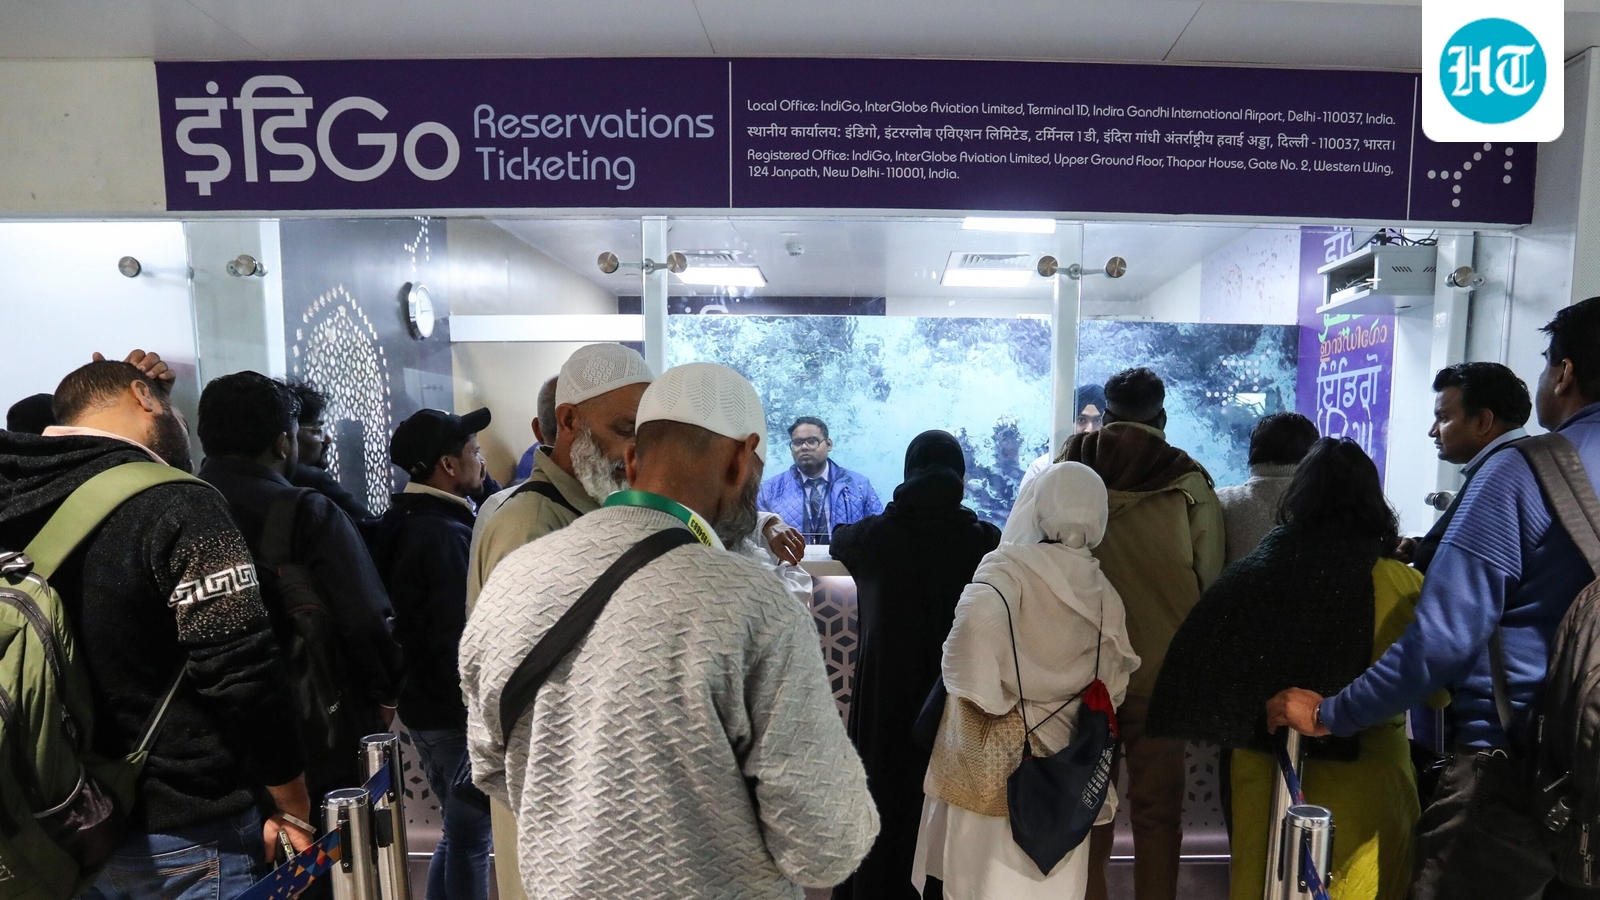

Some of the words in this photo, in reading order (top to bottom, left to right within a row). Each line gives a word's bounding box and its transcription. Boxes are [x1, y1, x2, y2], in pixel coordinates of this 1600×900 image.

[473, 104, 714, 139] Reservations
[747, 99, 776, 111] Local
[779, 99, 818, 111] Office:
[820, 99, 862, 113] IndiGo,
[865, 100, 928, 112] InterGlobe
[930, 101, 978, 113] Aviation
[981, 102, 1024, 115] Limited,
[1026, 103, 1074, 115] Terminal
[1076, 104, 1090, 117] 1D,
[1093, 104, 1124, 116] Indira
[1126, 105, 1169, 117] Gandhi
[1171, 106, 1242, 119] International
[1244, 108, 1285, 123] Airport,
[1365, 112, 1395, 124] India.
[746, 122, 787, 137] स्थानीय
[790, 122, 840, 137] कार्यालय:
[844, 123, 880, 139] इंडिगो,
[884, 124, 932, 140] इंटरग्लोब
[934, 124, 982, 142] एविएशन
[985, 125, 1031, 142] लिमिटेड,
[1035, 126, 1074, 141] टर्मिनल
[1103, 128, 1132, 144] इंदिरा
[1135, 129, 1161, 143] गांधी
[1216, 131, 1244, 147] हवाई
[1247, 135, 1273, 150] अड्डा,
[1277, 132, 1309, 148] दिल्ली
[475, 146, 635, 191] Ticketing
[747, 148, 809, 163] Registered
[811, 149, 849, 160] Office:
[852, 149, 893, 162] IndiGo,
[895, 150, 957, 162] InterGlobe
[959, 151, 1006, 163] Aviation
[1009, 152, 1051, 165] Limited,
[1054, 153, 1088, 167] Upper
[1090, 154, 1134, 165] Ground
[1135, 155, 1164, 167] Floor,
[1166, 156, 1206, 170] Thapar
[1208, 157, 1246, 170] House,
[1248, 158, 1277, 170] Gate
[1280, 159, 1298, 170] No.
[1300, 159, 1311, 172] 2,
[1313, 160, 1360, 172] Western
[1362, 161, 1393, 176] Wing,
[748, 165, 769, 177] 124
[770, 165, 820, 180] Janpath,
[823, 166, 849, 177] New
[928, 167, 959, 179] India.
